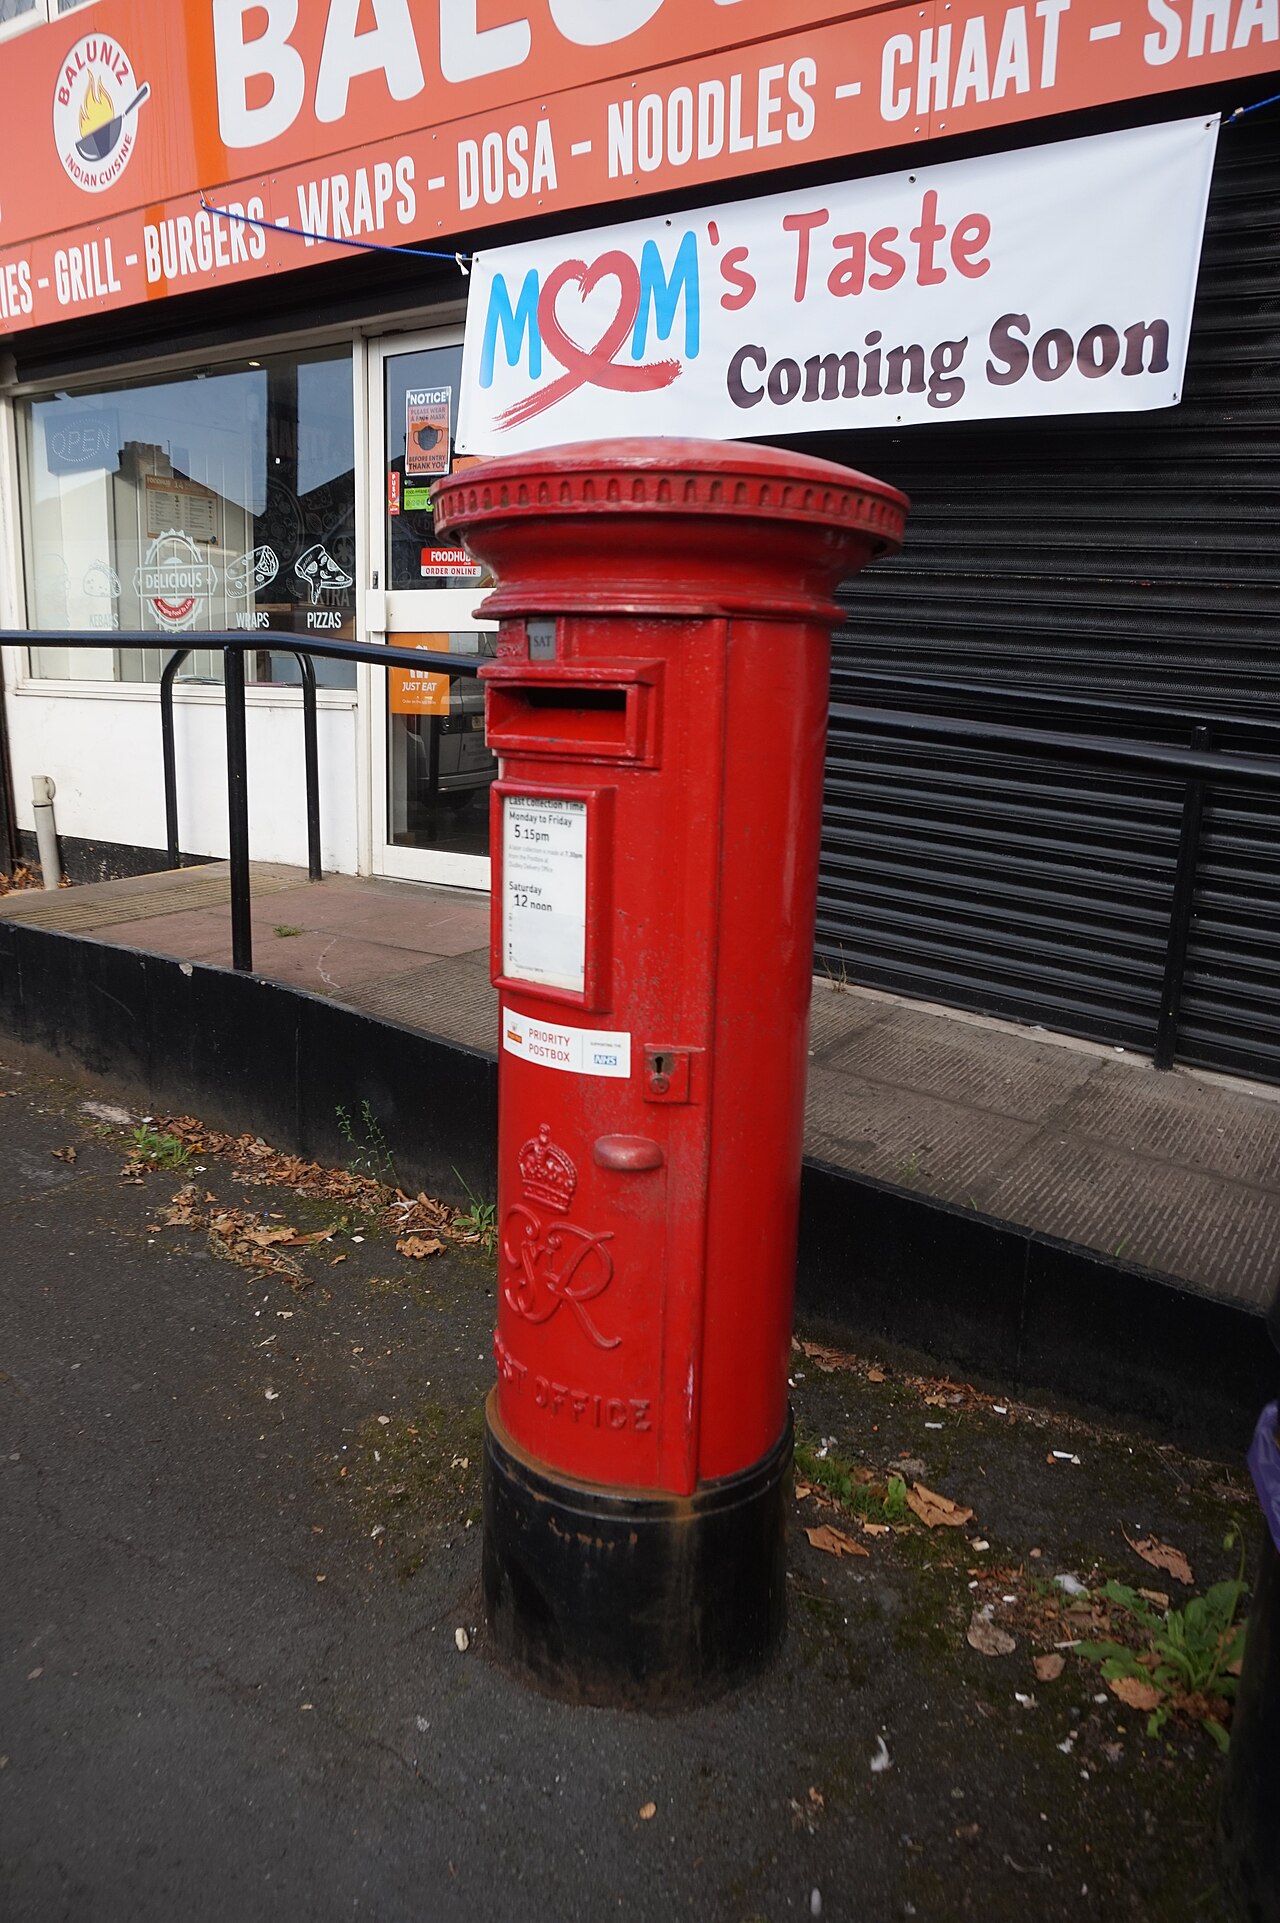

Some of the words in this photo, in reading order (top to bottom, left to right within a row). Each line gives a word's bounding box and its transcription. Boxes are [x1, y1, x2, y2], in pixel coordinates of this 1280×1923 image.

[57, 39, 129, 106] BALUNIZ
[0, 259, 33, 320] IES
[54, 237, 122, 305] GRILL
[143, 197, 267, 284] BURGERS
[297, 155, 417, 247] WRAPS
[457, 119, 558, 211] DOSA
[606, 57, 817, 179] NOODLES
[880, 0, 1071, 122] CHAAT
[65, 153, 98, 187] INDIAN
[99, 133, 133, 185] CUISINE
[781, 189, 992, 303] Taste
[726, 330, 970, 409] Coming
[985, 313, 1170, 387] Soon
[409, 392, 447, 405] NOTICE
[51, 421, 112, 457] OPEN
[408, 461, 431, 470] THANK
[431, 461, 446, 469] YOU
[425, 567, 449, 575] ORDER
[450, 567, 477, 575] ONLINE
[145, 572, 202, 589] DELICIOUS
[235, 611, 270, 629] WRAPS
[307, 611, 342, 629] PIZZAS
[533, 635, 552, 647] SAT
[401, 681, 421, 692] JUST
[421, 682, 438, 692] EAT
[509, 811, 538, 825] Monday
[539, 815, 547, 823] to
[548, 815, 573, 828] Friday
[514, 824, 550, 842] 5.15pm
[509, 881, 542, 896] Saturday
[514, 894, 528, 908] 12
[530, 901, 553, 912] noon
[528, 1028, 570, 1047] PRIORITY
[528, 1043, 570, 1062] POSTBOX
[594, 1054, 617, 1066] NHS
[534, 1374, 653, 1432] OFFICE
